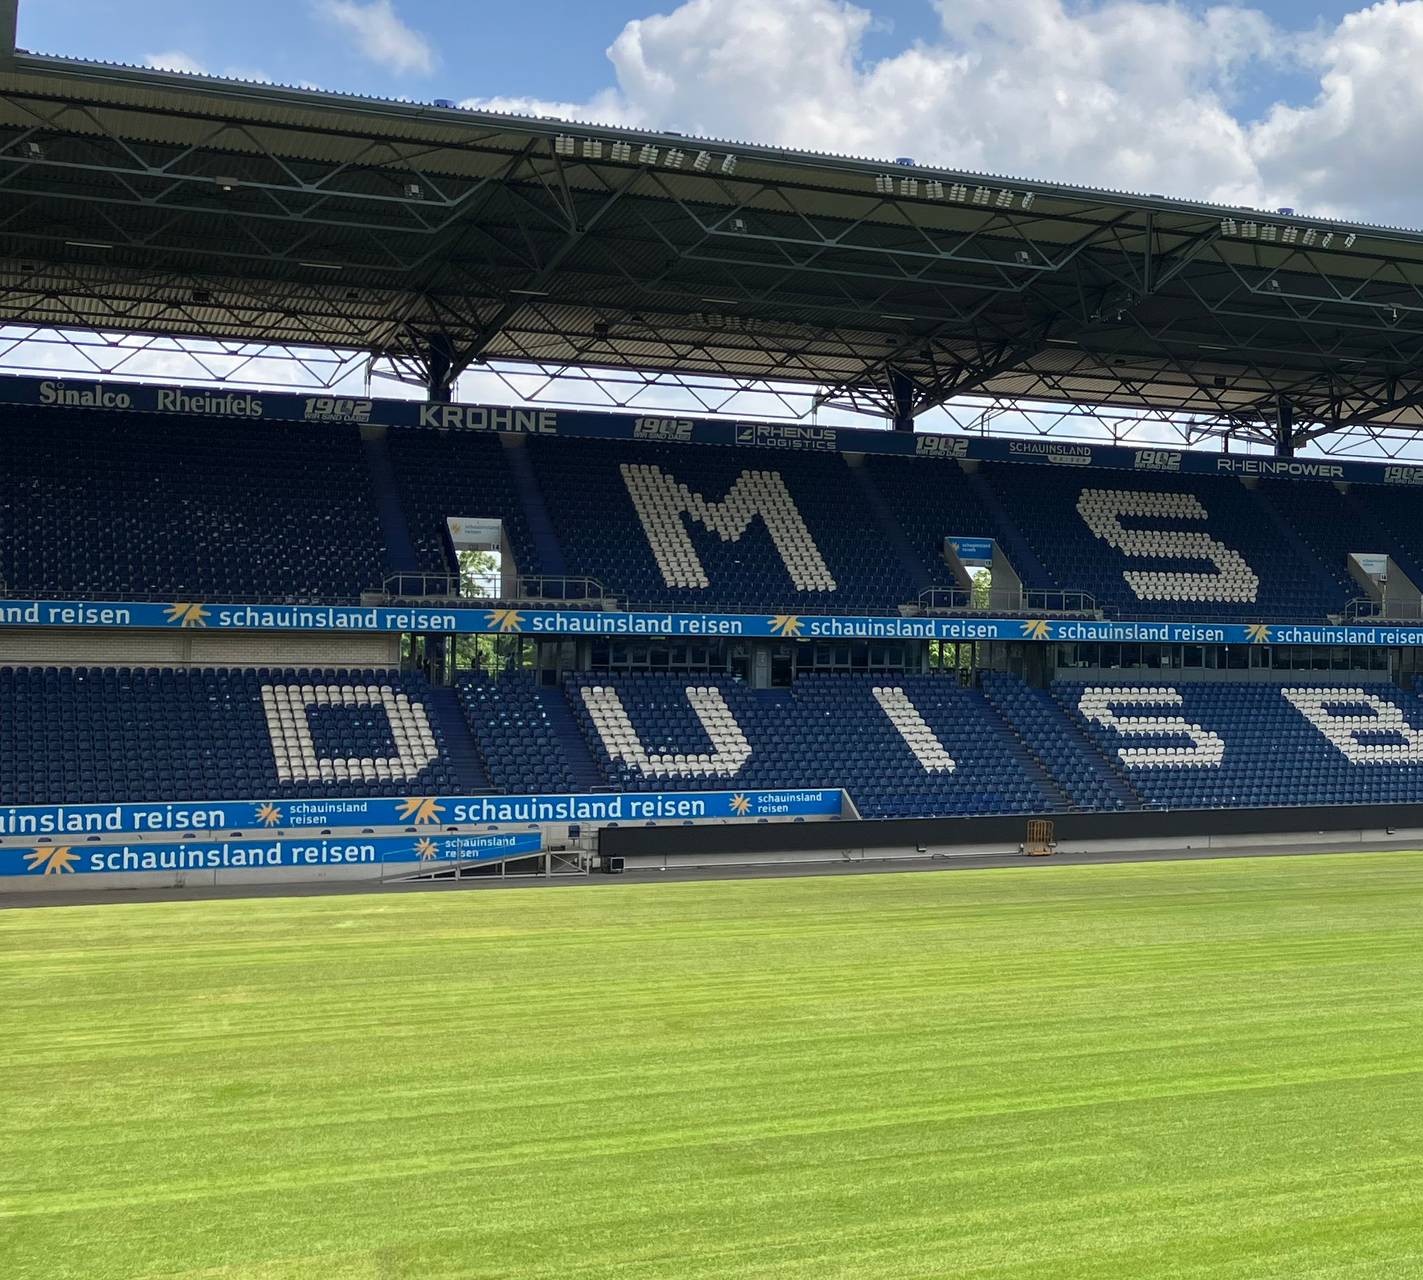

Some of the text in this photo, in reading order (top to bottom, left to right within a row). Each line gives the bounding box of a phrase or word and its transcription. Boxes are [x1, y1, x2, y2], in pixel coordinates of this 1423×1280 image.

[39, 381, 131, 409] Sinalco
[157, 389, 263, 417] Rheinfels
[305, 397, 373, 416] 1902
[419, 404, 558, 434] KROHNE
[633, 416, 695, 436] 1902
[757, 425, 837, 440] RHENUS
[757, 440, 837, 450] LOGISTICS
[916, 435, 969, 452] 1902
[1009, 442, 1091, 456] SCHAUINSLAND
[1134, 449, 1182, 467] 1902
[1217, 458, 1345, 478] RHEINPOWER
[49, 603, 131, 625] reisen
[219, 606, 456, 630] schauinsland reisen
[532, 613, 742, 634] schauinsland reisen
[810, 618, 997, 638] schauinsland reisen
[1058, 622, 1224, 641] schauinsland reisen
[1276, 625, 1376, 643] schauinsland
[757, 792, 822, 803] schauinsland
[133, 806, 225, 829] reisen
[289, 802, 368, 814] schauinsland
[454, 794, 705, 822] schauinsland reisen
[757, 803, 789, 813] reisen
[289, 814, 328, 825] reisen
[445, 836, 516, 848] schauinsland
[90, 840, 376, 871] schauinsland reisen
